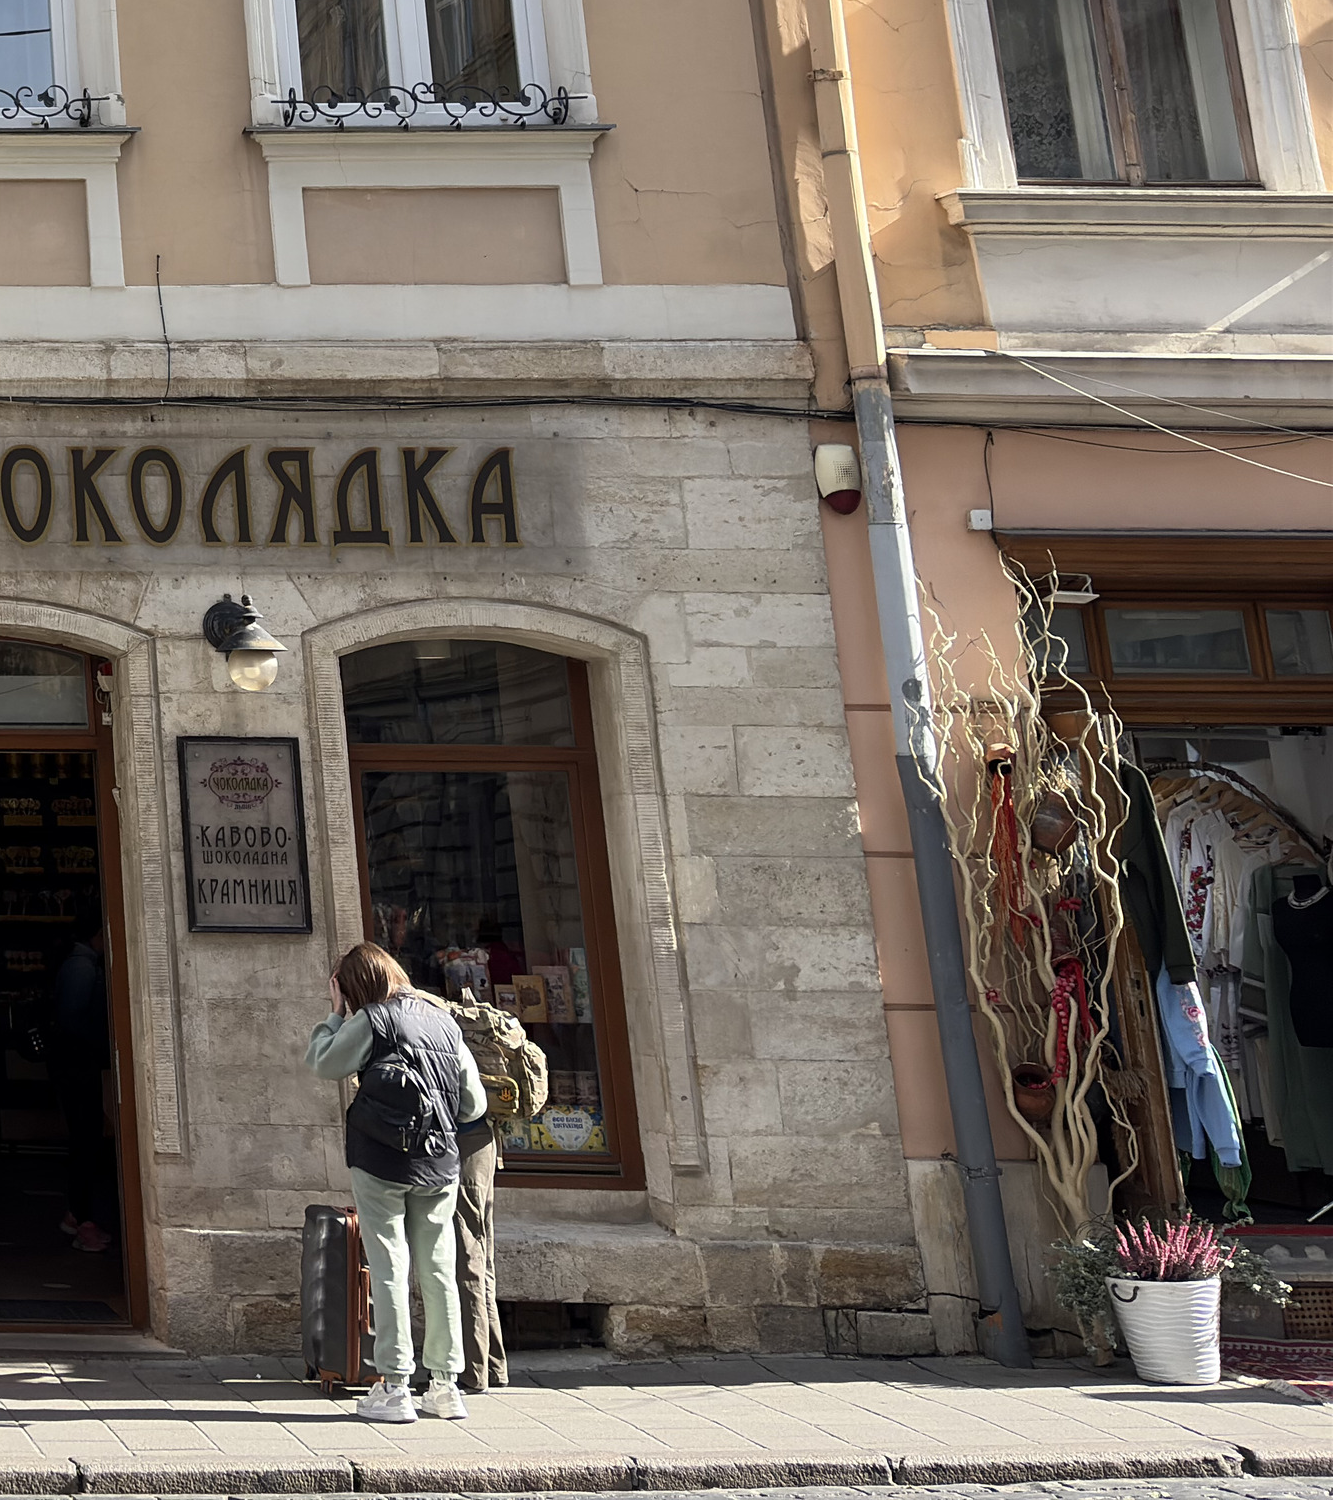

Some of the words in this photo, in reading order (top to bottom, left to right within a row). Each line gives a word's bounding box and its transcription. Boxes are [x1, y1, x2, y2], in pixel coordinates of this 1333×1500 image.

[212, 776, 269, 791] ЧОКОЛЯДКА
[200, 825, 287, 848] КАВОВО
[202, 850, 288, 865] ШОКОЛАДНА
[197, 878, 298, 905] КРАМНИЦЯ
